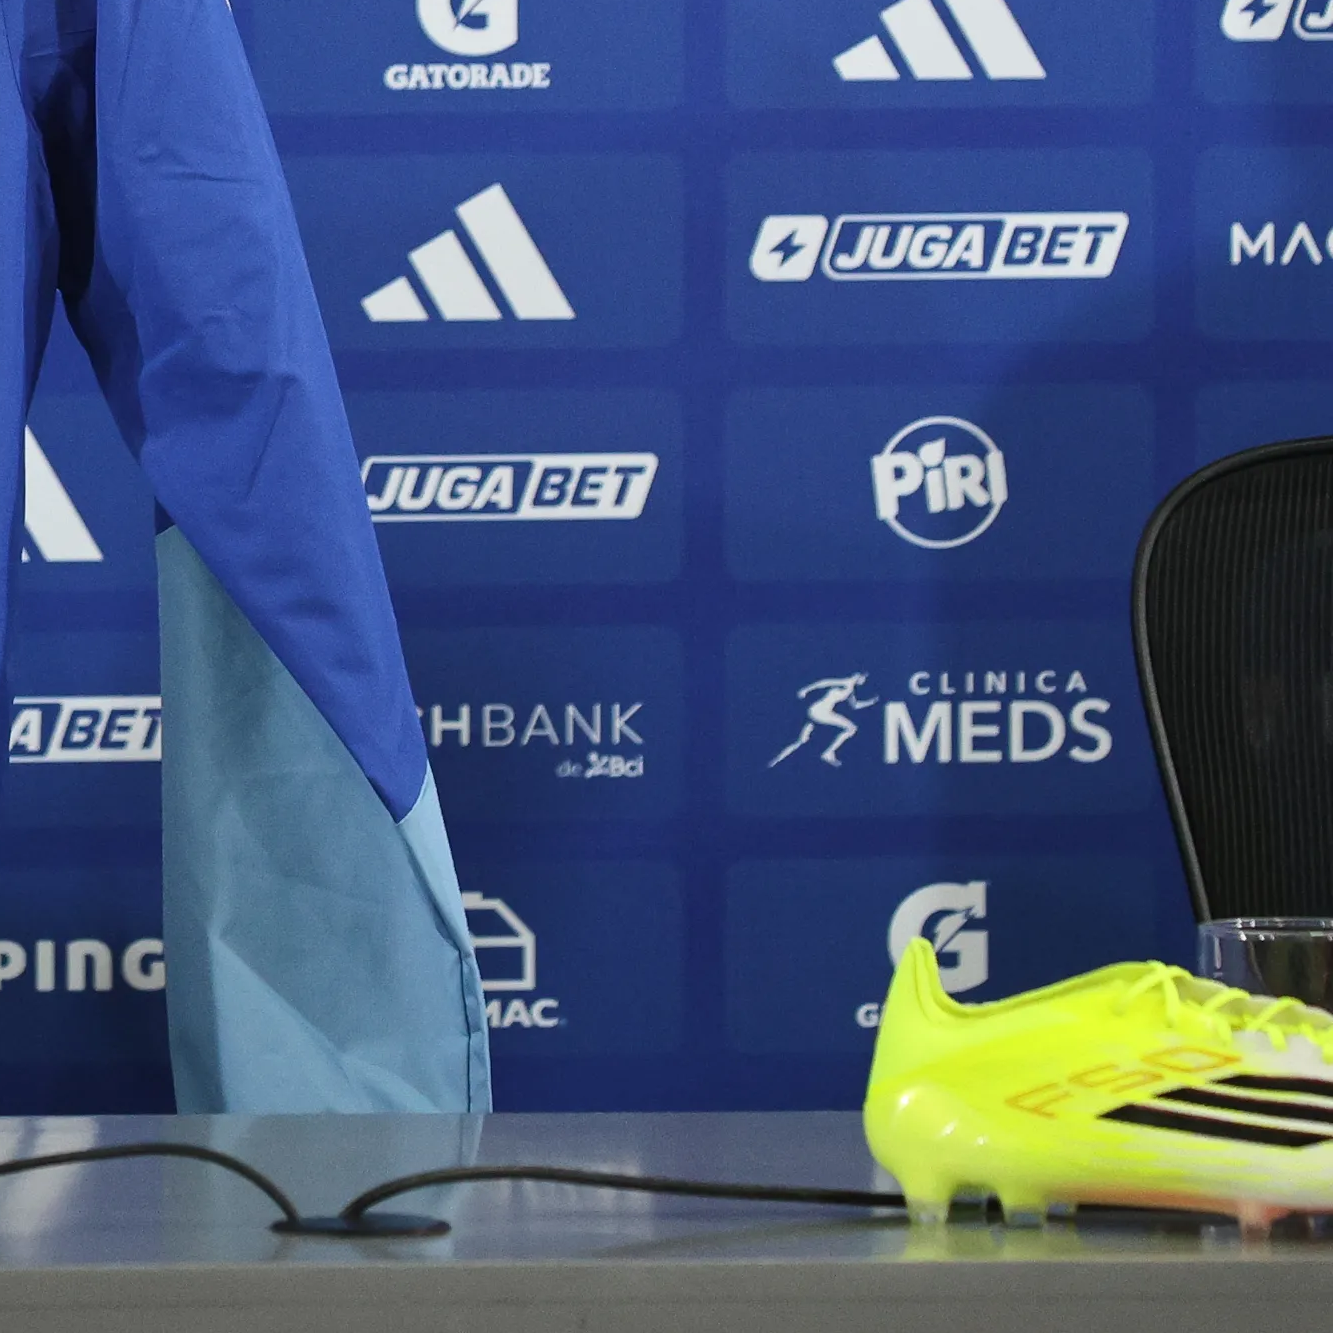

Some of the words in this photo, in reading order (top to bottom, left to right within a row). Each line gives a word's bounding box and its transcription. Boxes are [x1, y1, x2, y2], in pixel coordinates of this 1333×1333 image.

[385, 63, 550, 89] GATORADE
[909, 671, 1086, 695] CLINICA
[9, 708, 161, 752] ABET
[418, 702, 643, 747] HBANK
[885, 699, 1111, 763] MEDS
